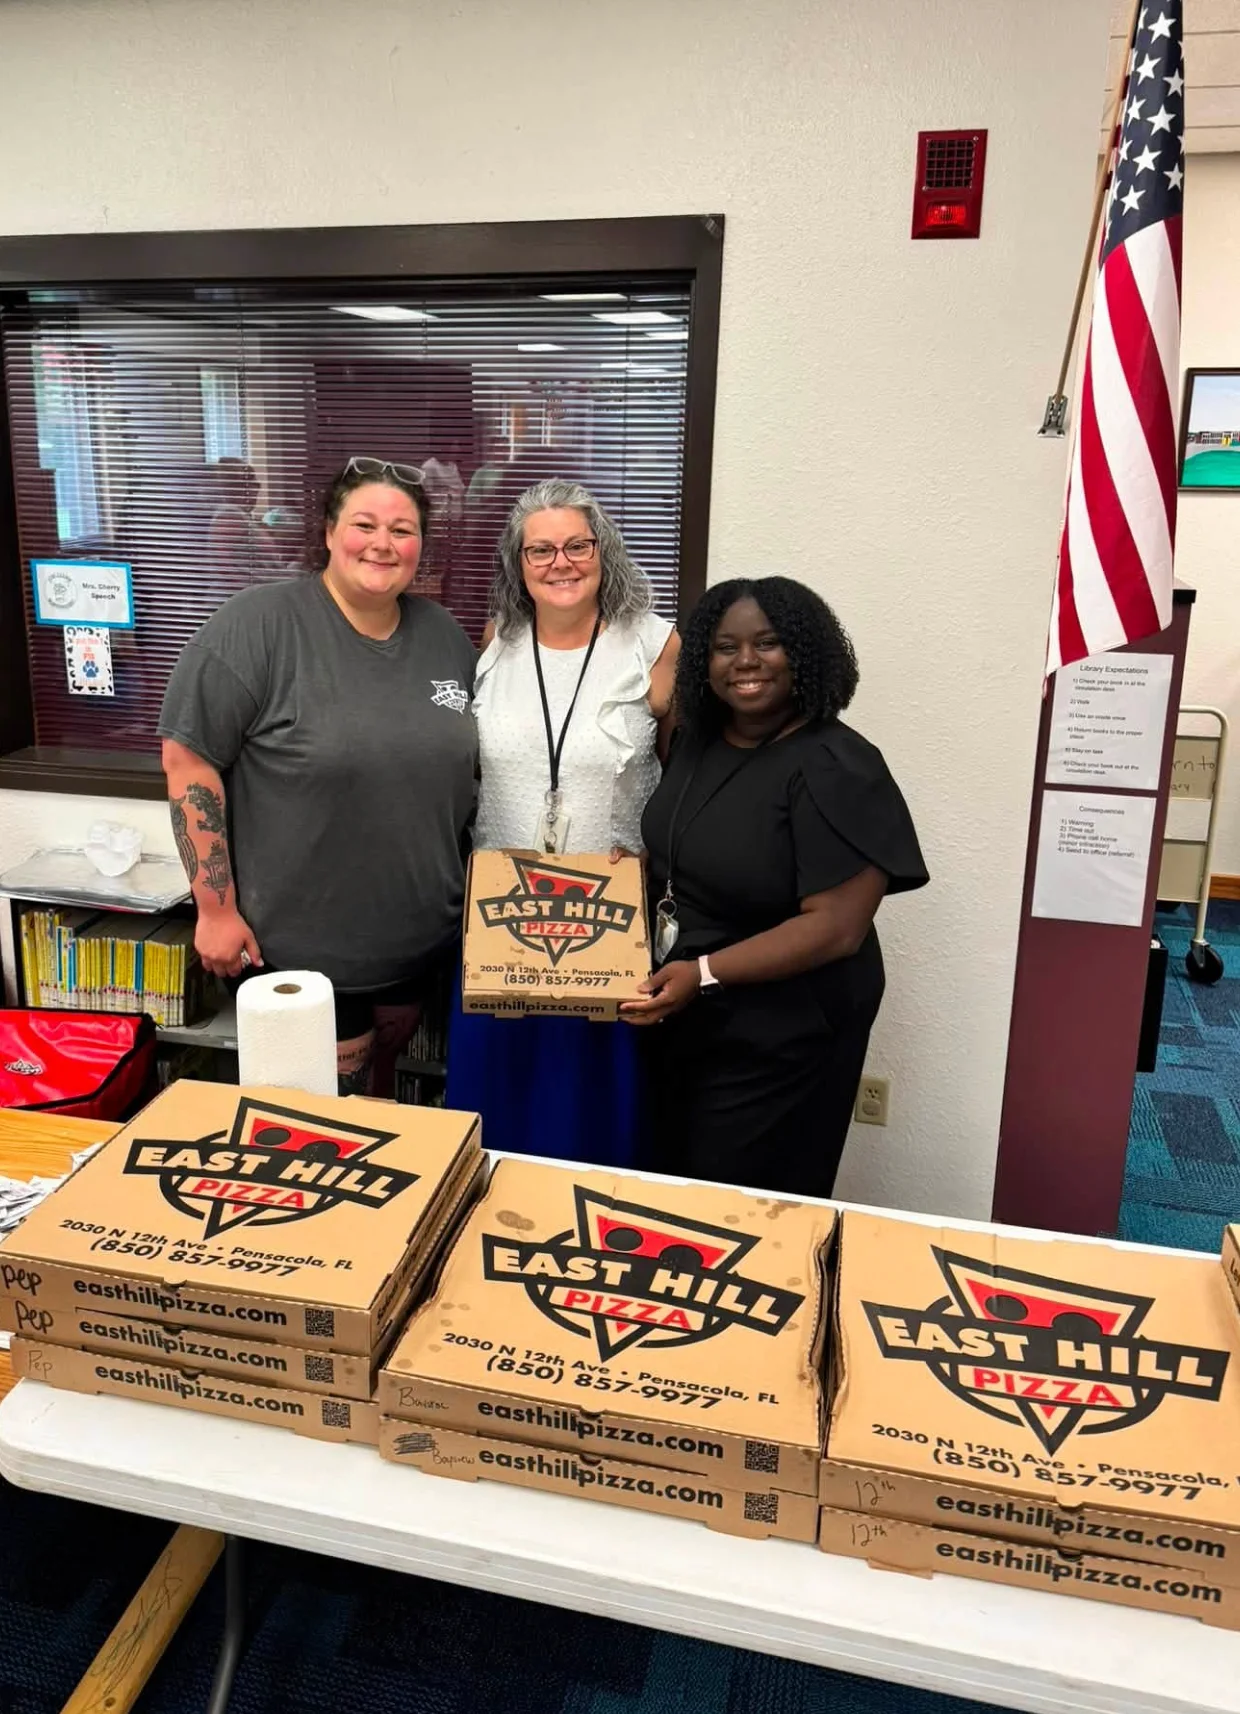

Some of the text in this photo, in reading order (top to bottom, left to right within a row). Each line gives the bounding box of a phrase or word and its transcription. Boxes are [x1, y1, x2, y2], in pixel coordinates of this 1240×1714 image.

[91, 592, 116, 600] Speech
[1080, 665, 1148, 674] Library Expectations
[1079, 806, 1125, 815] Consequences
[485, 900, 628, 925] EAST HILL
[526, 922, 588, 935] PIZZA
[480, 965, 504, 973] 2030
[519, 966, 539, 974] 12th
[572, 968, 622, 978] Pensacola,
[504, 974, 611, 987] (850) 857-9977
[470, 1001, 605, 1013] easthillpizza.com
[138, 1146, 392, 1198] EAST HILL
[191, 1179, 304, 1209] PIZZA
[58, 1219, 354, 1270] 2030 N 12th Ave Pensacola, FL
[91, 1238, 300, 1278] (850) 857-9977
[74, 1279, 287, 1326] easthillpizza.com
[494, 1246, 782, 1323] EAST HILL
[563, 1289, 692, 1330] PIZZA
[29, 1350, 52, 1379] Pep
[79, 1319, 287, 1372] easthillpizza.com
[877, 1316, 1214, 1388] EAST HILL
[95, 1363, 304, 1416] easthillpizza.com
[442, 1333, 779, 1404] 2030 N 12th Ave Pensacola, FL
[486, 1356, 722, 1408] (850) 857-9977
[973, 1368, 1122, 1407] PIZZA
[478, 1400, 724, 1458] easthillpizza.com
[479, 1448, 724, 1508] easthillpizza.com
[872, 1424, 929, 1445] 2030
[936, 1436, 955, 1450] N
[964, 1442, 1014, 1460] 12th
[1022, 1451, 1066, 1470] Ave
[1098, 1462, 1230, 1488] Pensacola,
[932, 1447, 1203, 1500] (850) 857-9977
[856, 1480, 896, 1508] 12th
[850, 1522, 888, 1546] 12th
[936, 1494, 1226, 1558] easthillpizza.com
[936, 1540, 1222, 1603] easthillpizza.com
